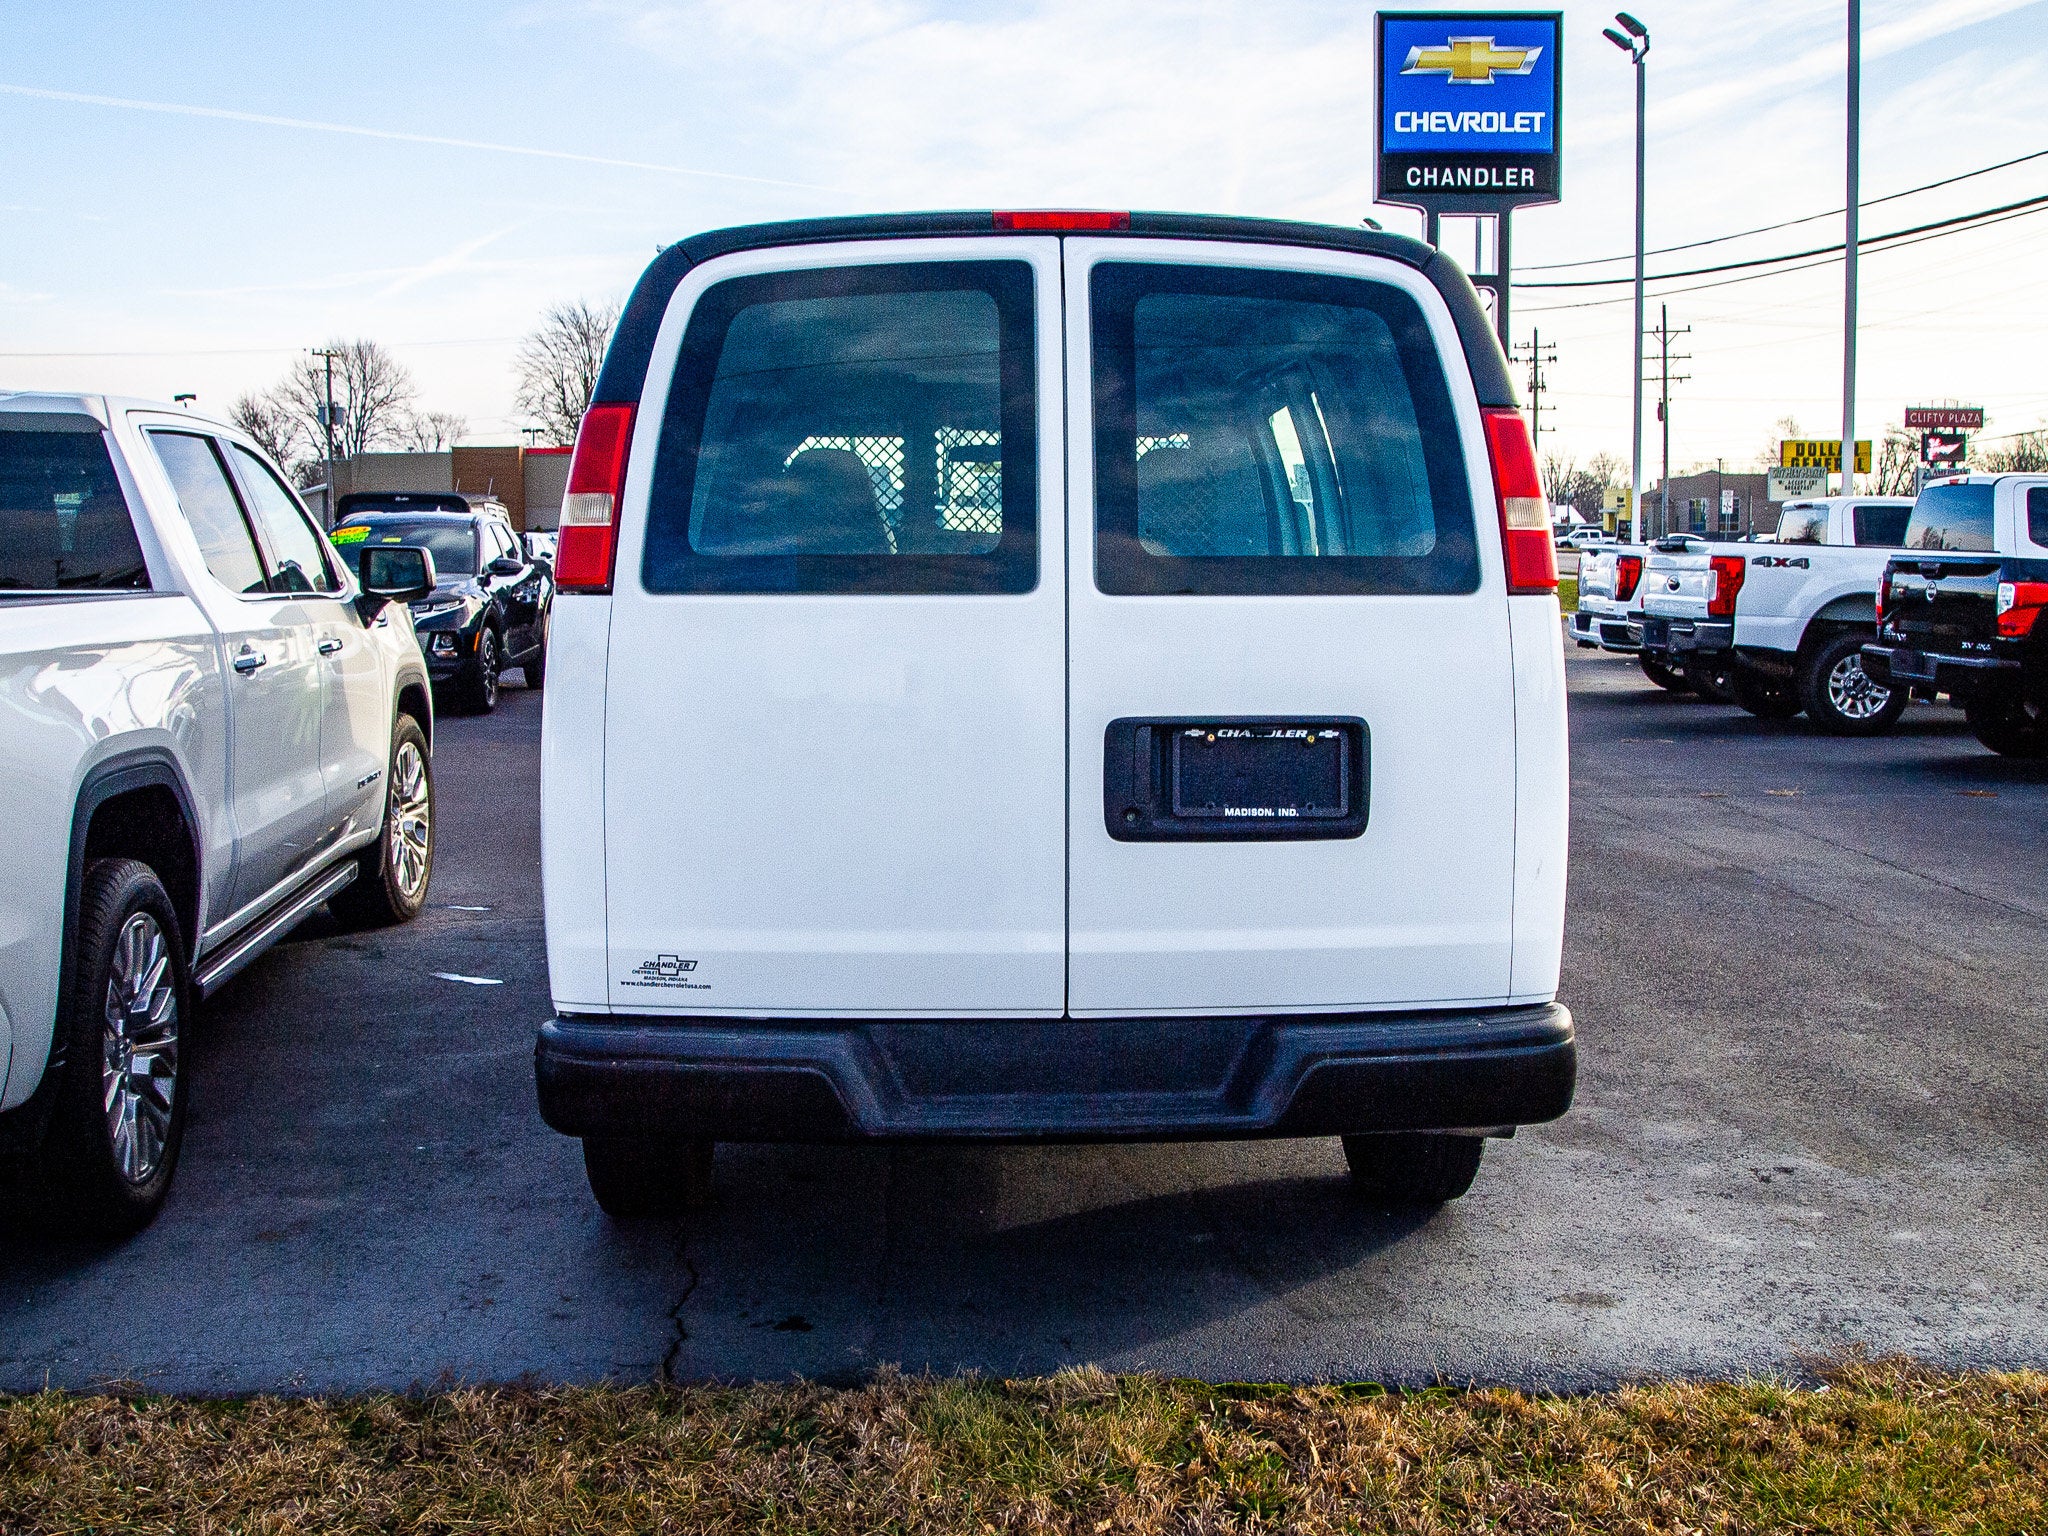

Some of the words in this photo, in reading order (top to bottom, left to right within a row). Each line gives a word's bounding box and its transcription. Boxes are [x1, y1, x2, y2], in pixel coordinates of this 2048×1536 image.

[1394, 111, 1546, 133] CHEVROLET
[1406, 167, 1535, 187] CHANDLER
[1909, 411, 1945, 423] CLIFTY
[1948, 412, 1981, 424] PLAZA
[1791, 457, 1864, 471] GENERL
[1217, 729, 1308, 738] CHALER
[1278, 807, 1300, 817] IND.
[643, 961, 690, 969] CHANDLER
